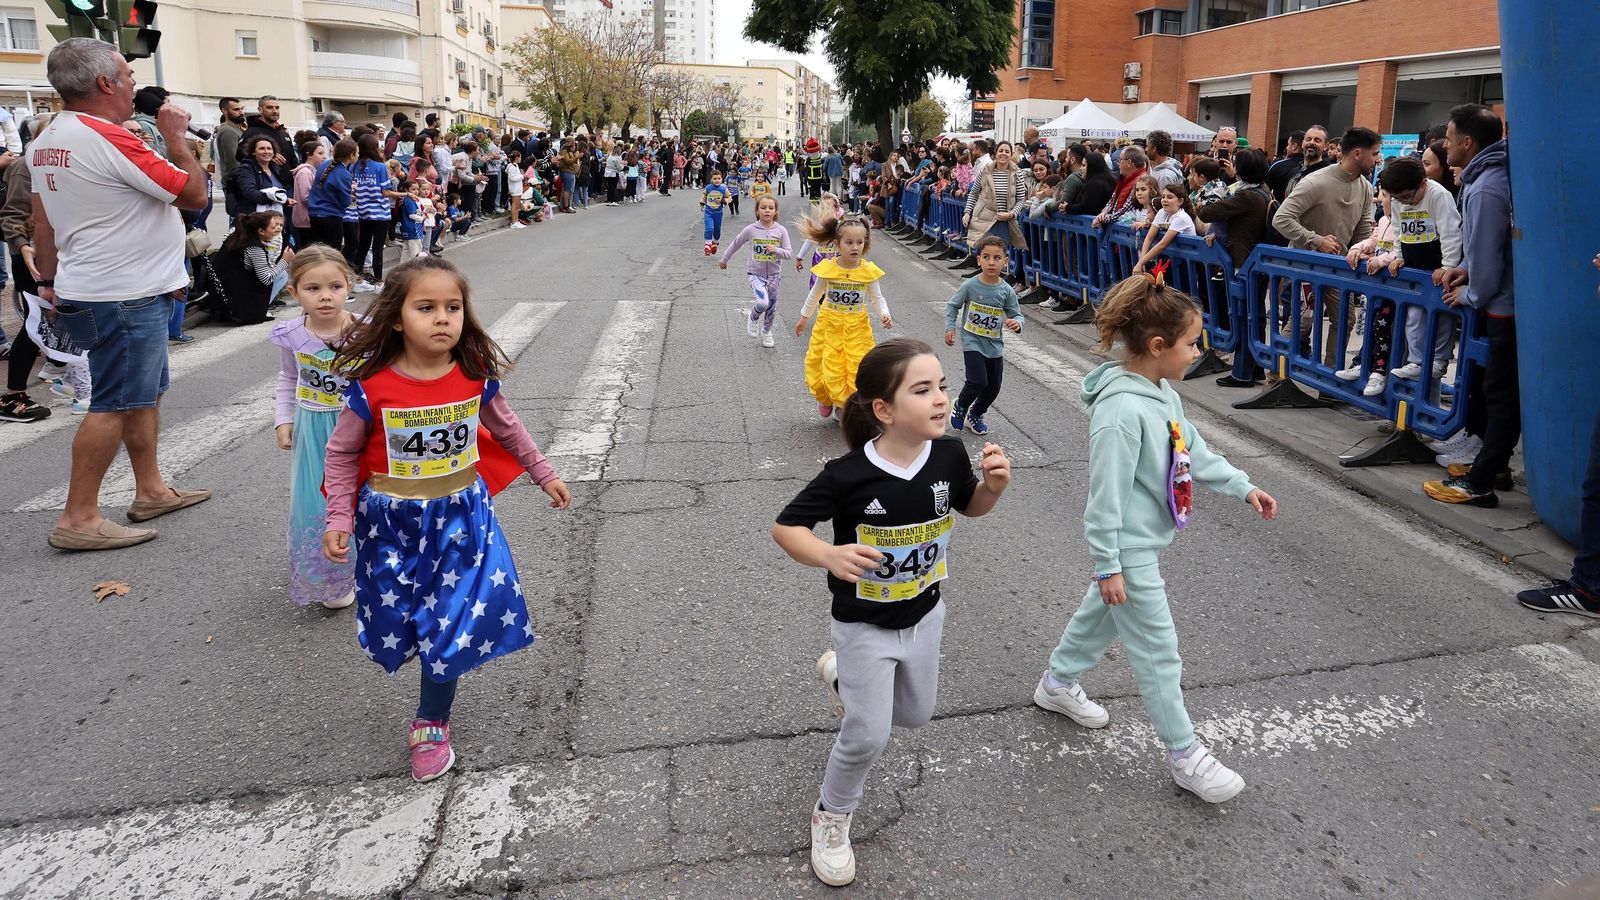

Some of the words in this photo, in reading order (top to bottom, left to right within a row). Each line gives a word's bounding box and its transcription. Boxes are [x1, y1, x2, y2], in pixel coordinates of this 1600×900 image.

[1401, 221, 1427, 233] 005
[756, 245, 768, 254] 07
[832, 291, 860, 303] 362
[972, 313, 999, 328] 245
[390, 409, 422, 419] CARRERA
[423, 406, 453, 417] INFANTIL
[453, 399, 477, 413] BENEFICA
[404, 417, 443, 427] BOMBEROS
[443, 415, 453, 423] DE
[453, 412, 468, 422] JEREZ
[402, 424, 469, 456] 439
[863, 526, 893, 537] CARRERA
[894, 525, 924, 537] INFANTIL
[925, 515, 950, 532] BENEFICA
[876, 536, 914, 547] BOMBEROS
[914, 535, 923, 544] DE
[924, 529, 940, 541] JEREZ
[873, 543, 939, 579] 349
